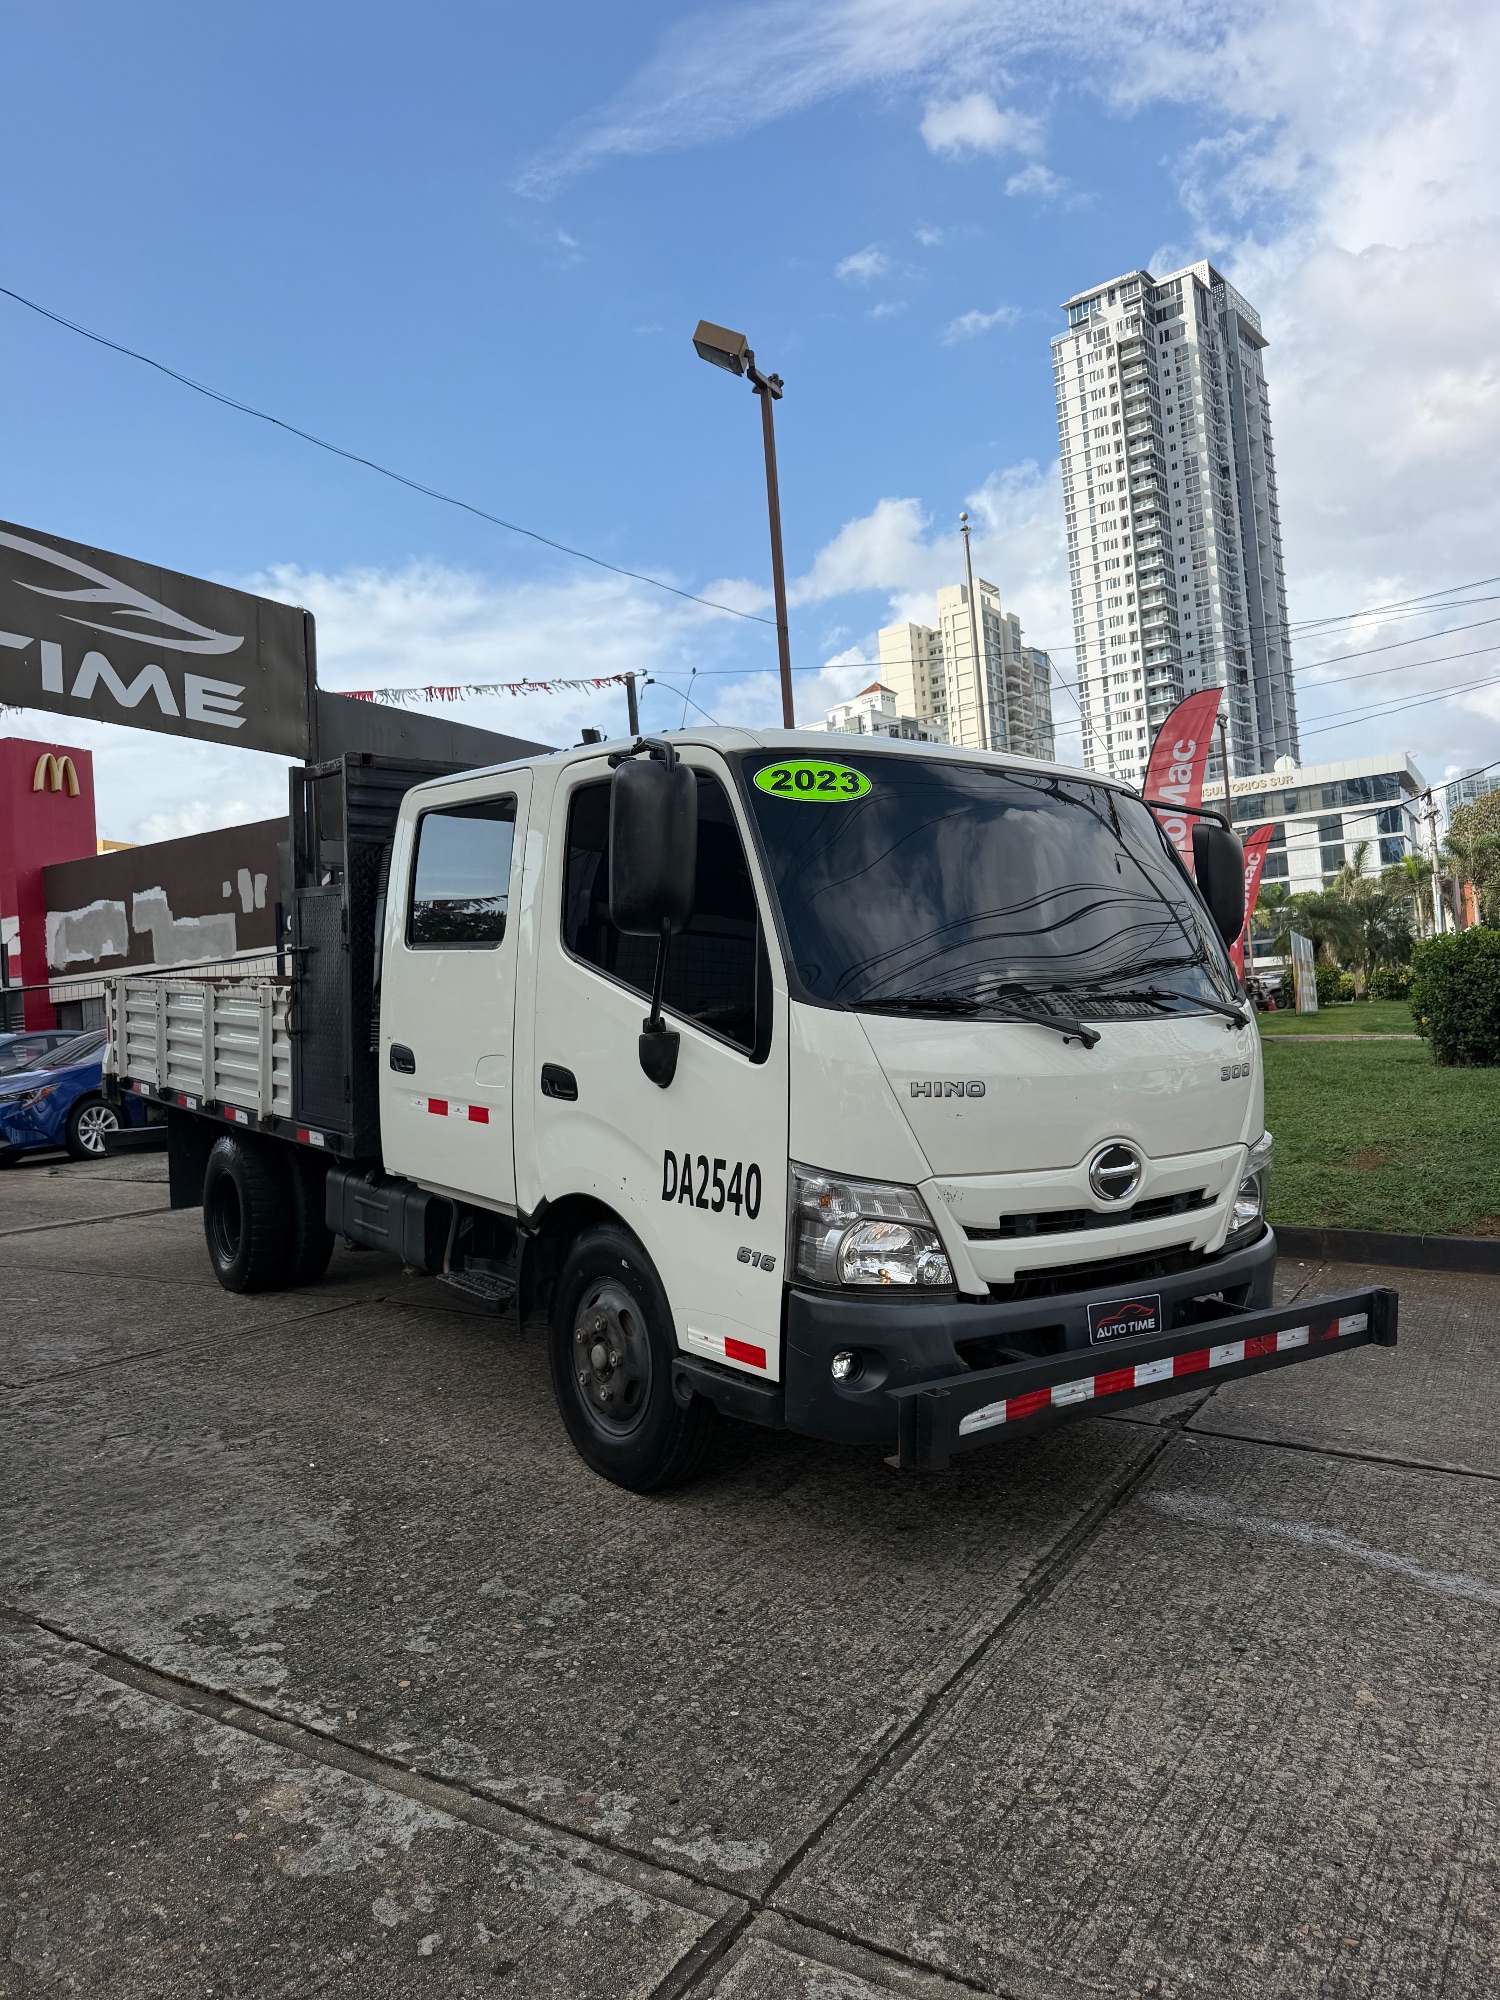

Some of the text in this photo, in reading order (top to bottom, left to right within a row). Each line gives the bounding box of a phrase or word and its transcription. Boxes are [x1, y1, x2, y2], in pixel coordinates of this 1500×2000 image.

[770, 769, 861, 794] 2023
[1269, 775, 1294, 787] SUR
[1221, 1063, 1250, 1081] 300
[911, 1081, 985, 1097] HINO
[662, 1149, 761, 1220] DA2540
[736, 1246, 776, 1272] 616
[1096, 1318, 1155, 1338] AUTO TIME
